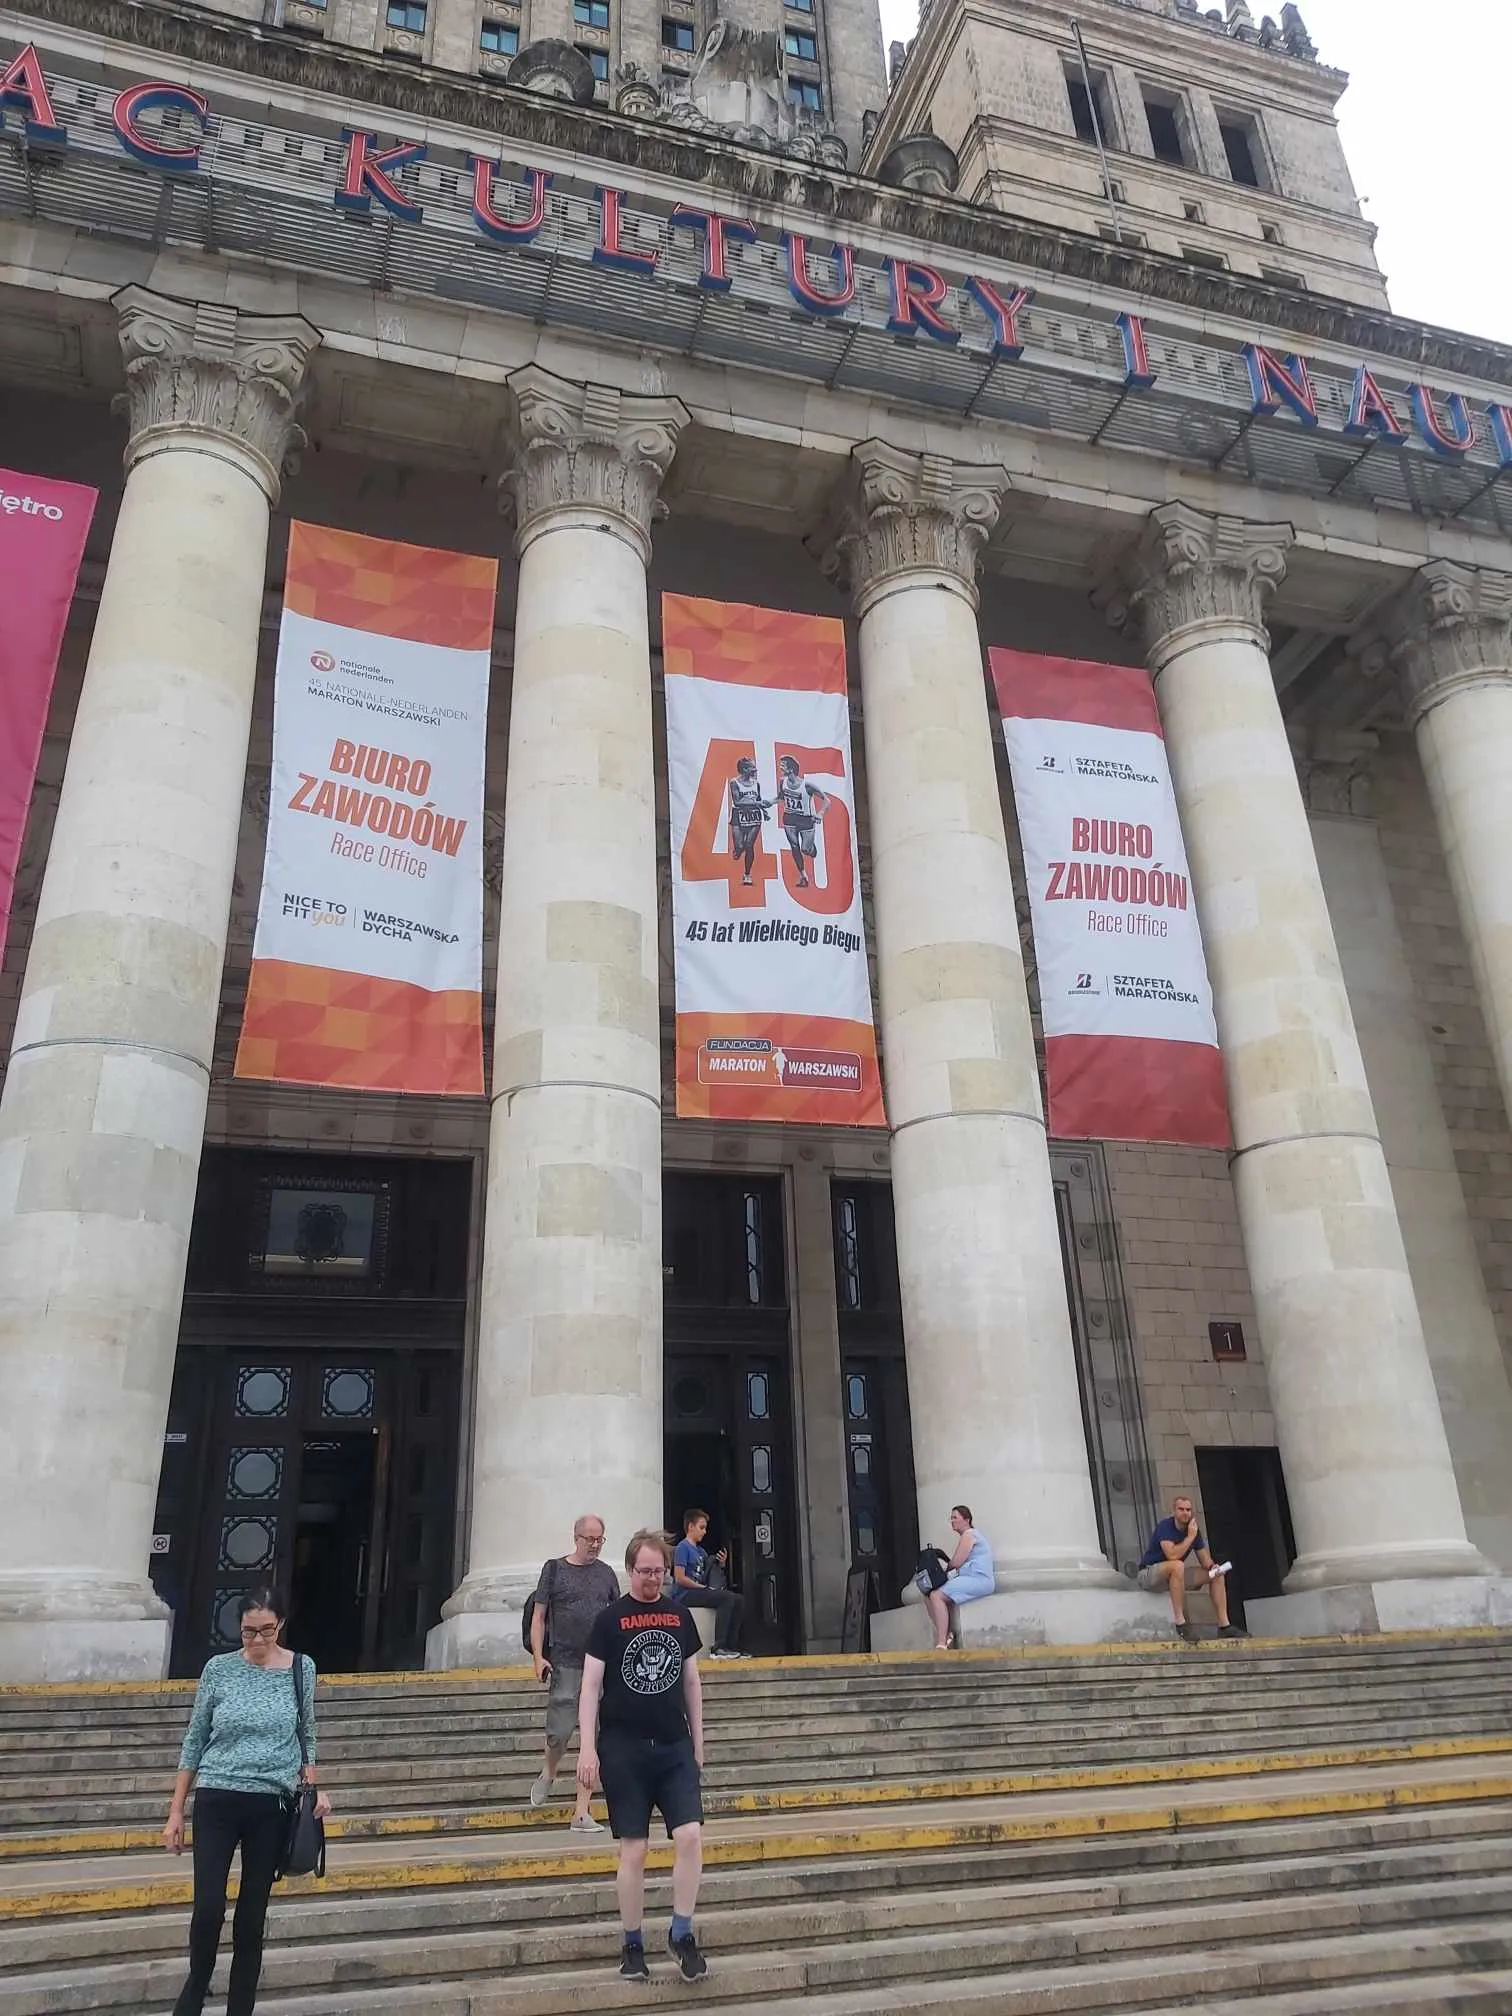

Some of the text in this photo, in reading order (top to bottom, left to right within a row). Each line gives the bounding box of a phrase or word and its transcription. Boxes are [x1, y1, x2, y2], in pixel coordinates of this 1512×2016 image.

[335, 126, 1034, 359] KULTURY
[1116, 312, 1156, 388] I
[339, 666, 395, 685] nederlanden
[340, 658, 381, 674] nationale
[307, 686, 442, 727] MARATON WARSZAWSKI
[329, 738, 432, 797] BIURO
[1075, 757, 1133, 772] SZTAFETA
[287, 772, 468, 858] ZAWODÓW
[1072, 817, 1153, 859] BIURO
[330, 832, 428, 879] Race Office
[1045, 862, 1188, 911] ZAWODÓW
[283, 893, 348, 915] NICE TO
[362, 920, 413, 942] DYCHA
[363, 909, 460, 944] WARSZAWSKA
[1088, 909, 1168, 938] Race Office
[685, 919, 861, 953] 45 lat Wielkiego Biegu
[1113, 975, 1175, 990] SZTAFETA
[710, 1040, 770, 1051] FUNDACJA
[709, 1057, 859, 1079] MARATON WARSZAWSKI
[1223, 1330, 1233, 1350] 1
[620, 1613, 681, 1630] RAMONES
[635, 1631, 672, 1646] JOHNNY
[623, 1646, 637, 1686] TOMMY
[671, 1646, 681, 1669] JOEY
